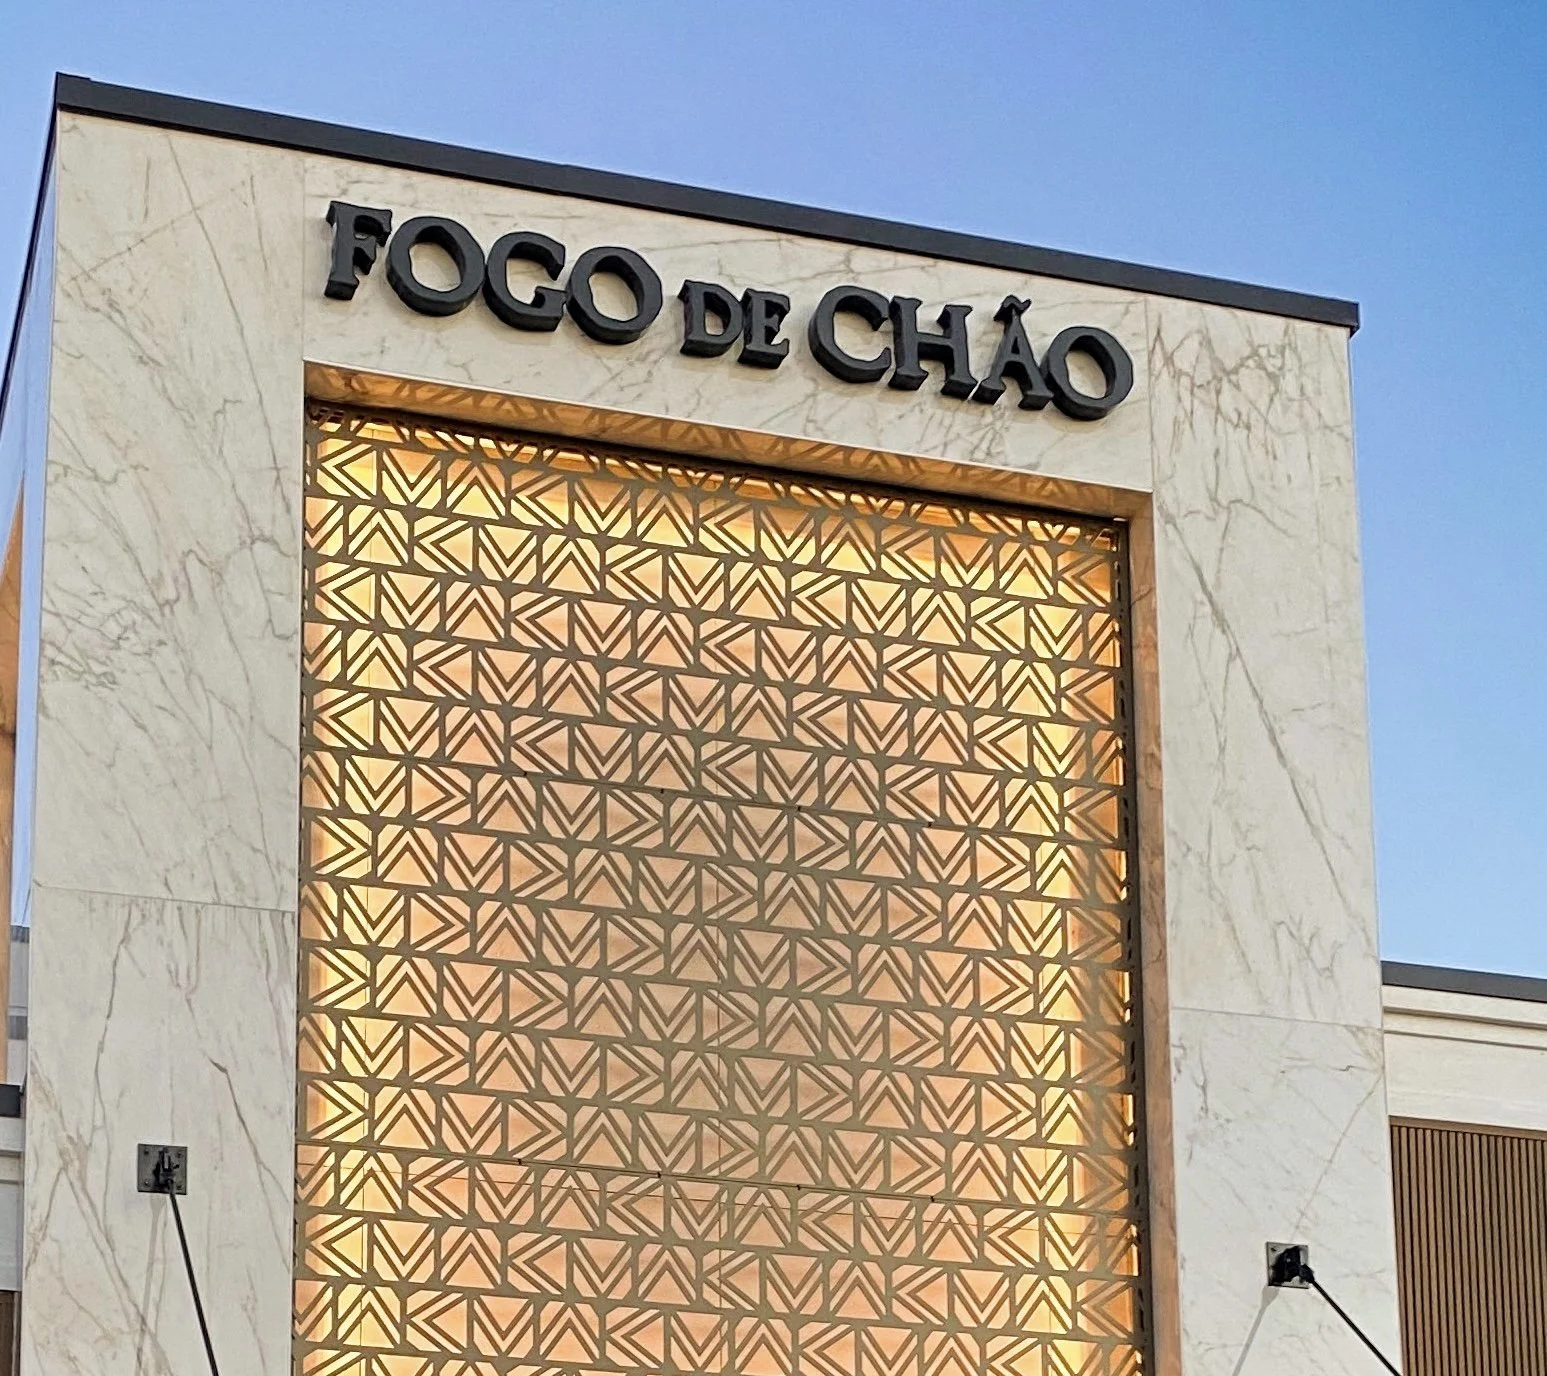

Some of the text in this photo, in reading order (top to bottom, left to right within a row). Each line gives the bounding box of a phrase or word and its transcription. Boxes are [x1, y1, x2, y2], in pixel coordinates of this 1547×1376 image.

[325, 201, 1133, 421] FOGO DE CHÃO
